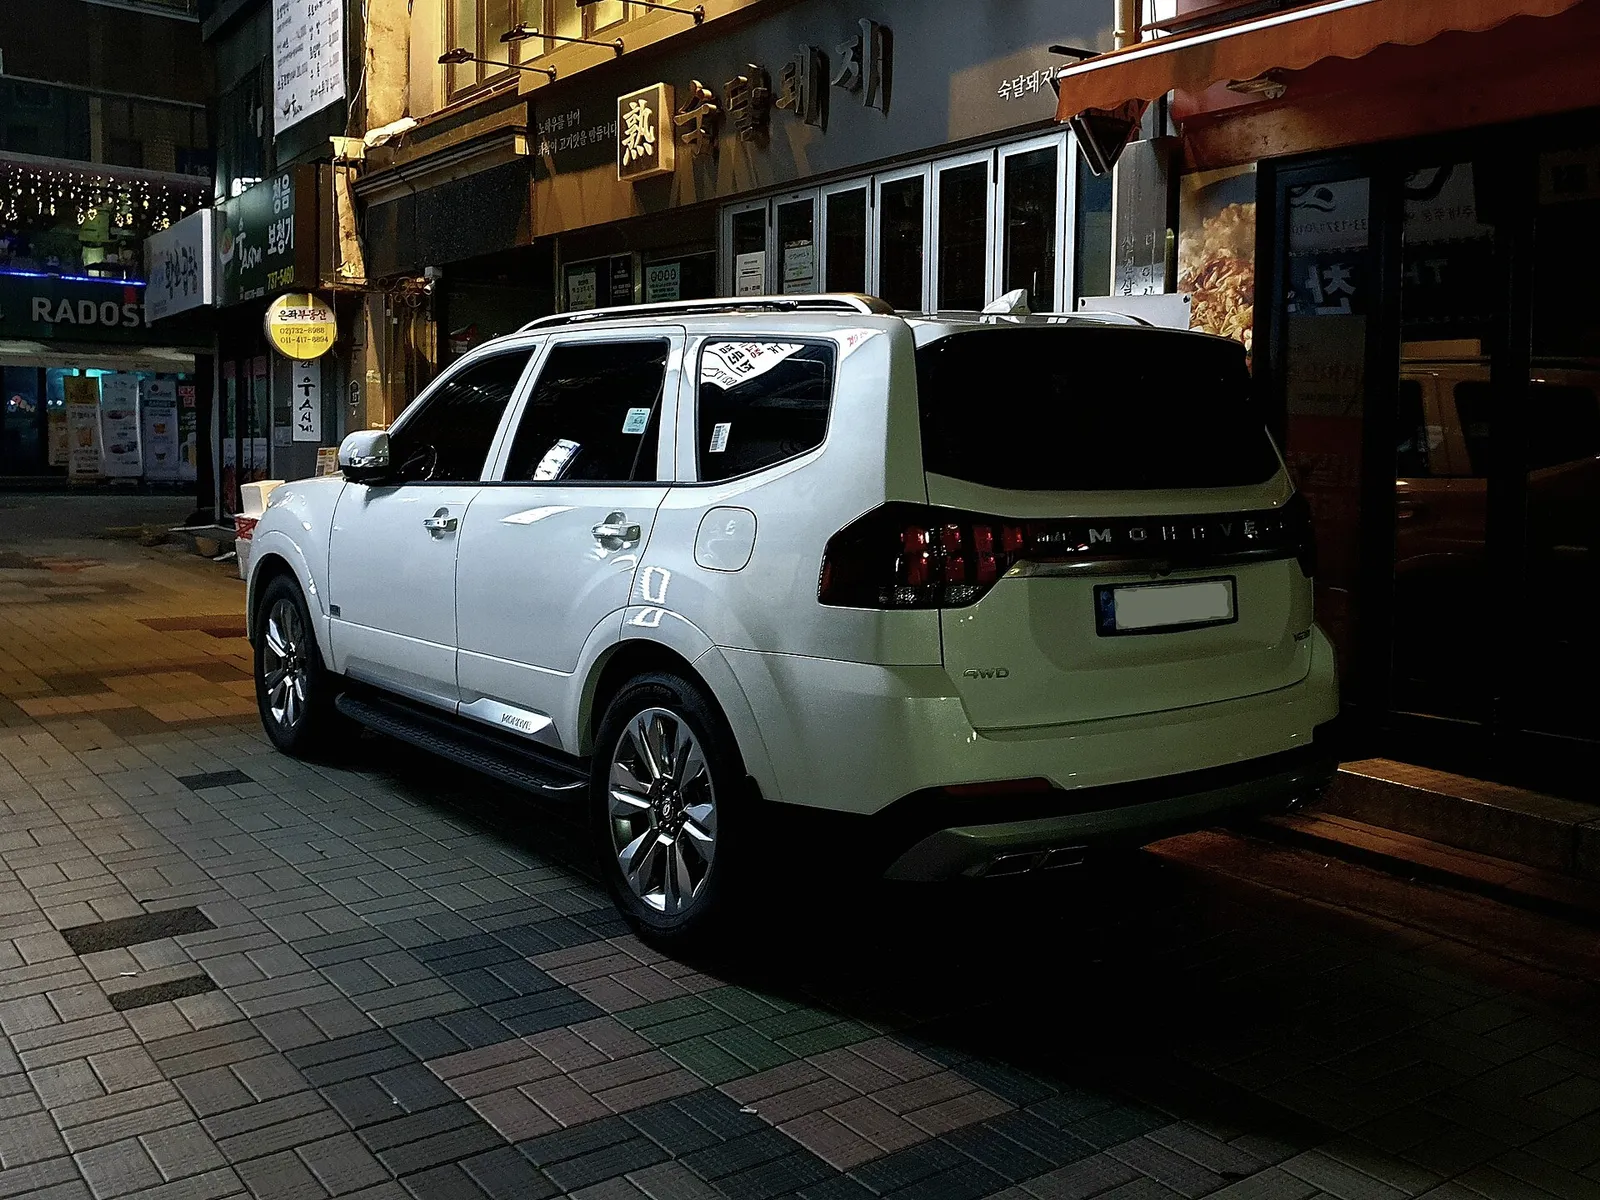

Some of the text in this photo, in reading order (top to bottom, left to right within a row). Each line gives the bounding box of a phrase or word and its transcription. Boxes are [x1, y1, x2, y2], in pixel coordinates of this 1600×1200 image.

[673, 17, 890, 158] 숙달돼지
[621, 99, 656, 167] 熟
[272, 173, 291, 215] 청음
[267, 214, 294, 256] 보청기
[963, 668, 1011, 680] 4WD
